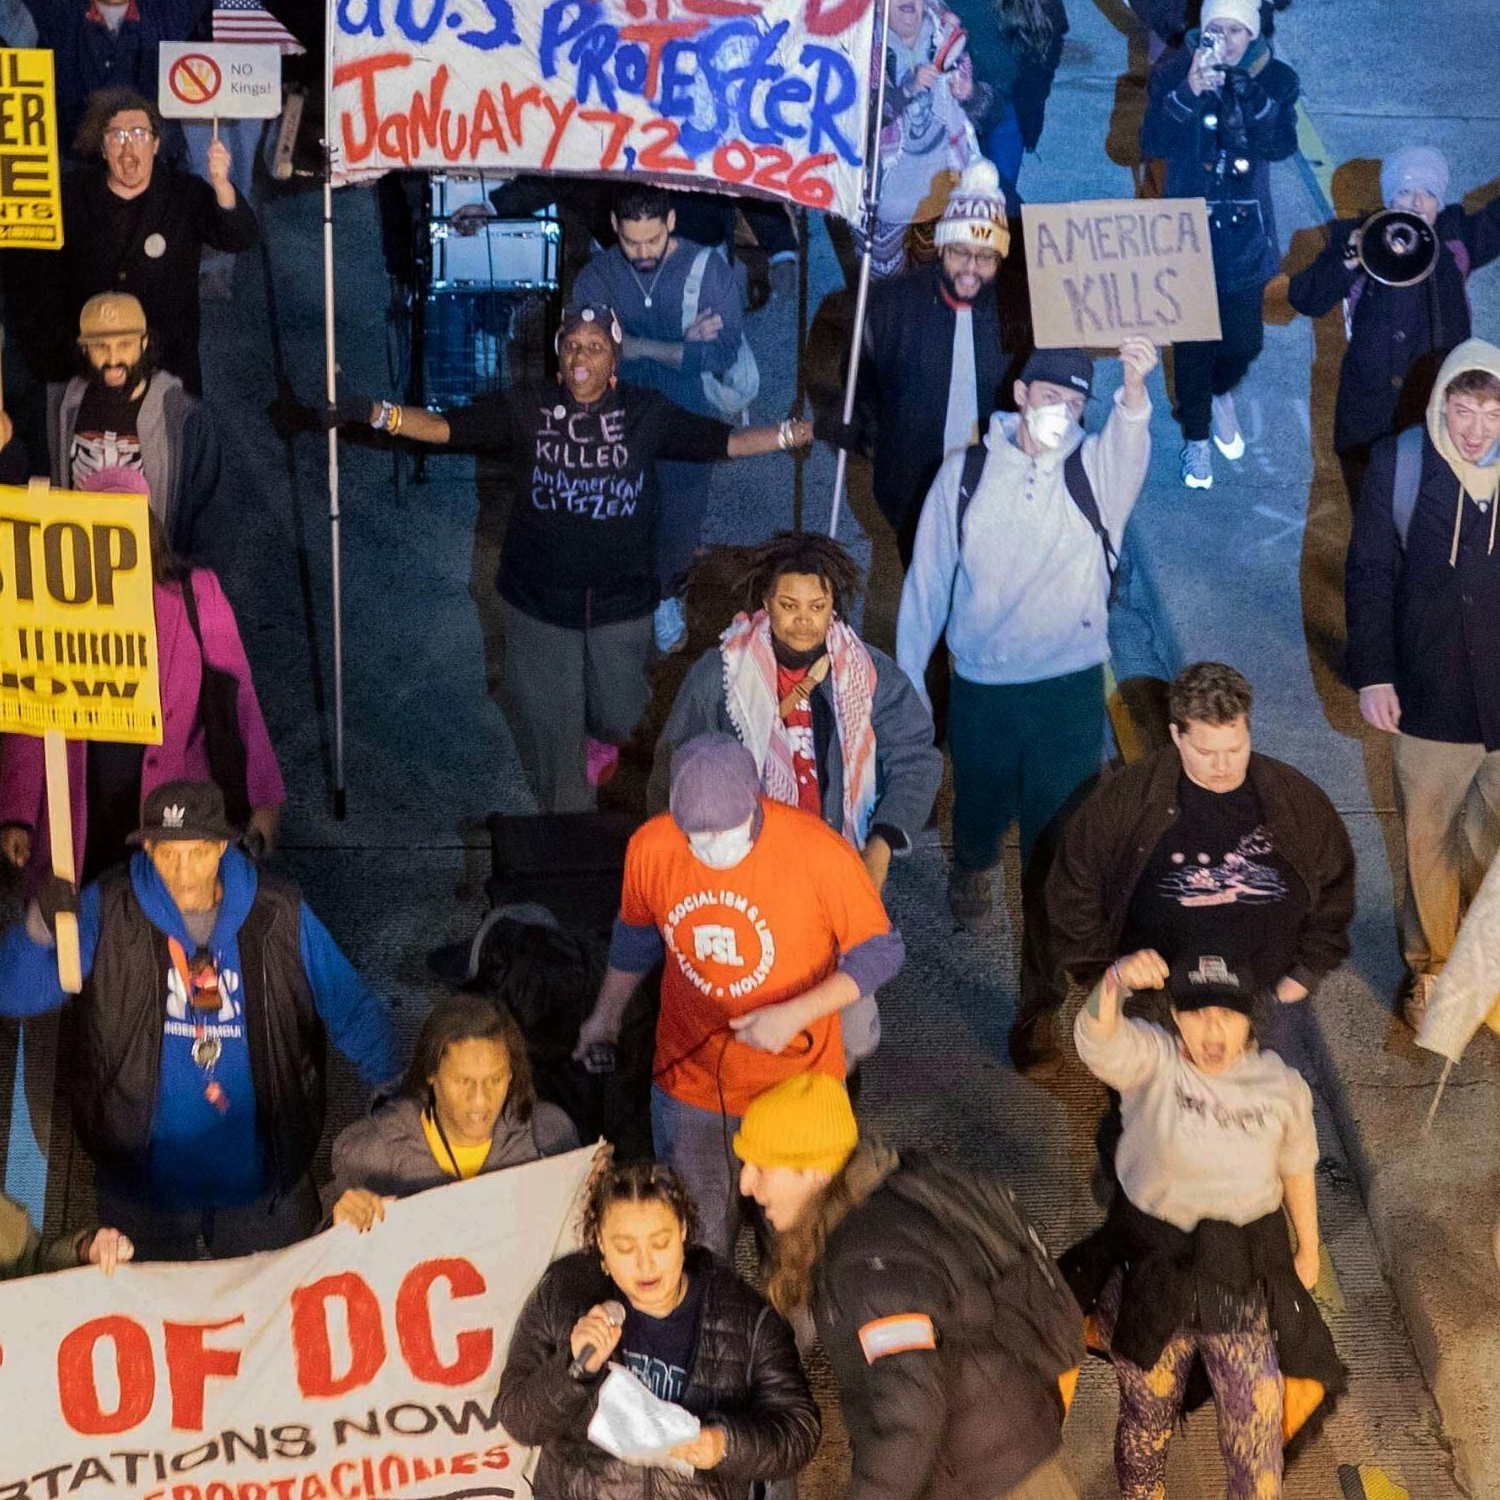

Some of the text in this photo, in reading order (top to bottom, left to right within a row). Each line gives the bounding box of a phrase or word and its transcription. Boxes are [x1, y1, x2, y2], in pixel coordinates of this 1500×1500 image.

[230, 63, 253, 76] NO
[230, 82, 271, 97] Kings!
[1035, 211, 1202, 269] AMERICA
[1062, 268, 1184, 335] KILLS
[535, 407, 627, 445] ICE
[535, 440, 630, 469] KILLED
[667, 889, 749, 927] SOCIALISM
[691, 924, 745, 967] PSL
[57, 1312, 246, 1436] OF
[291, 1255, 495, 1400] DC
[333, 1399, 502, 1446] NOW
[144, 1442, 512, 1500] PORTACIONES
